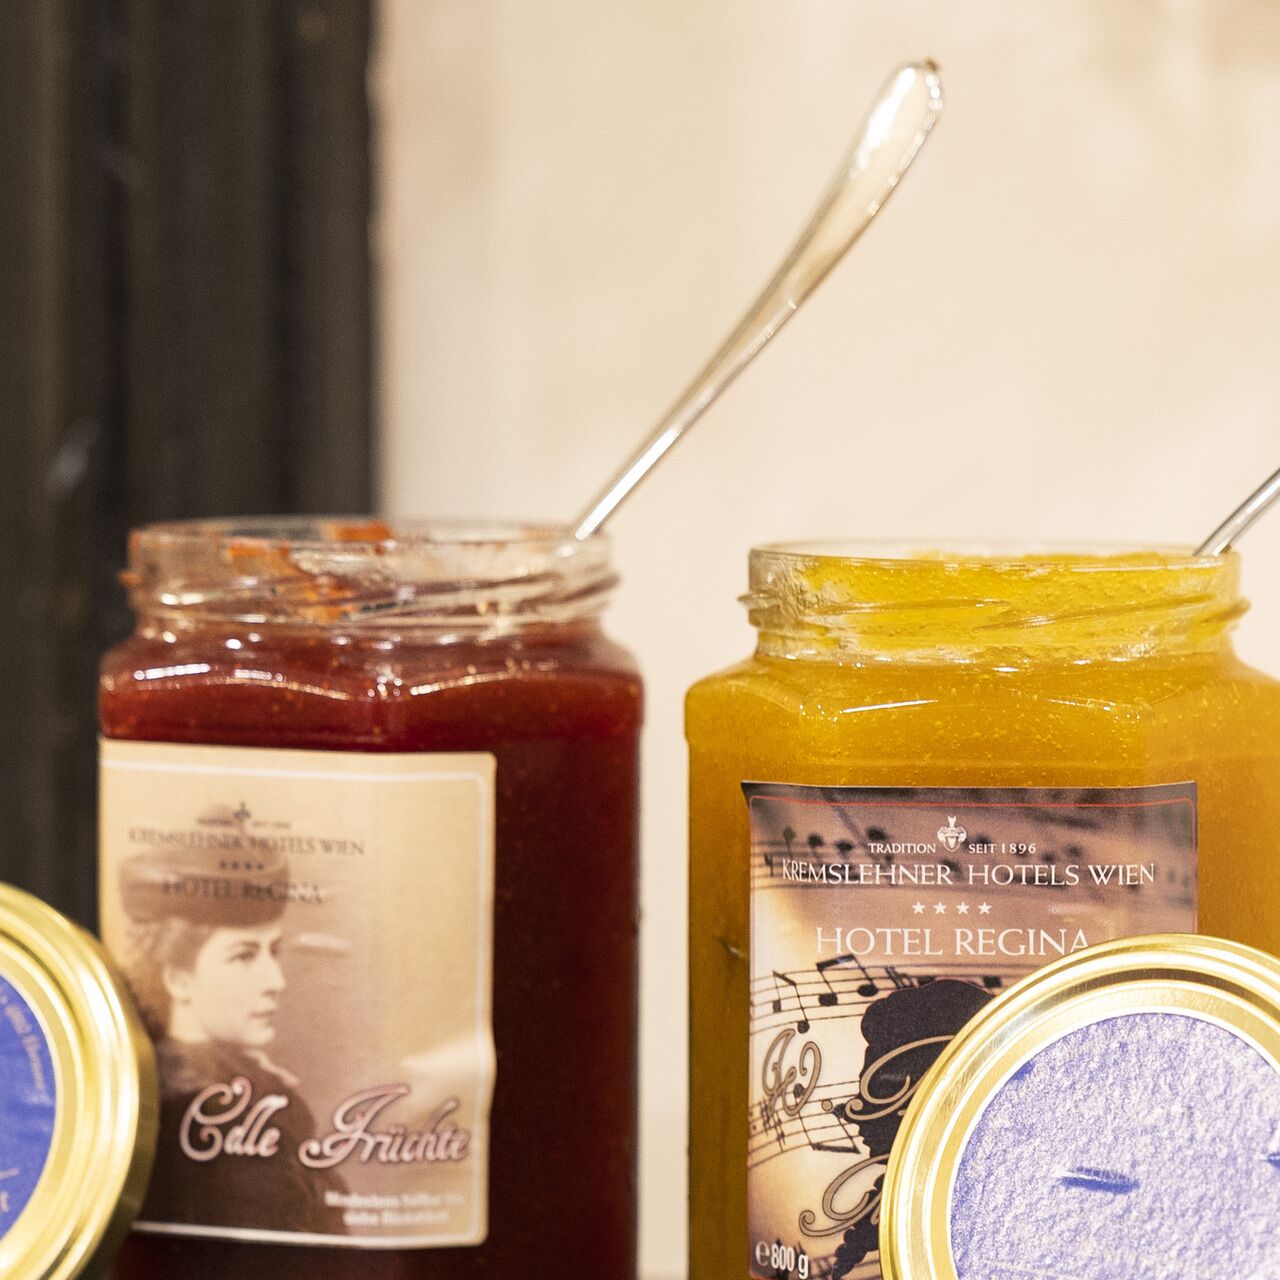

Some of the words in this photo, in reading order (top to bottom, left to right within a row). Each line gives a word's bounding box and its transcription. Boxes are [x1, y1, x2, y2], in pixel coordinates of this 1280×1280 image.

[868, 842, 936, 854] TRADITION
[968, 843, 997, 855] SEIT
[1000, 843, 1036, 854] 1896
[782, 860, 952, 886] KREMSLEHNER
[967, 864, 1079, 886] HOTELS
[1088, 863, 1155, 885] WIEN
[816, 927, 943, 956] HOTEL
[955, 927, 1090, 956] REGINA
[299, 1083, 470, 1170] Früchte
[771, 1245, 795, 1271] 800
[798, 1253, 809, 1278] g
